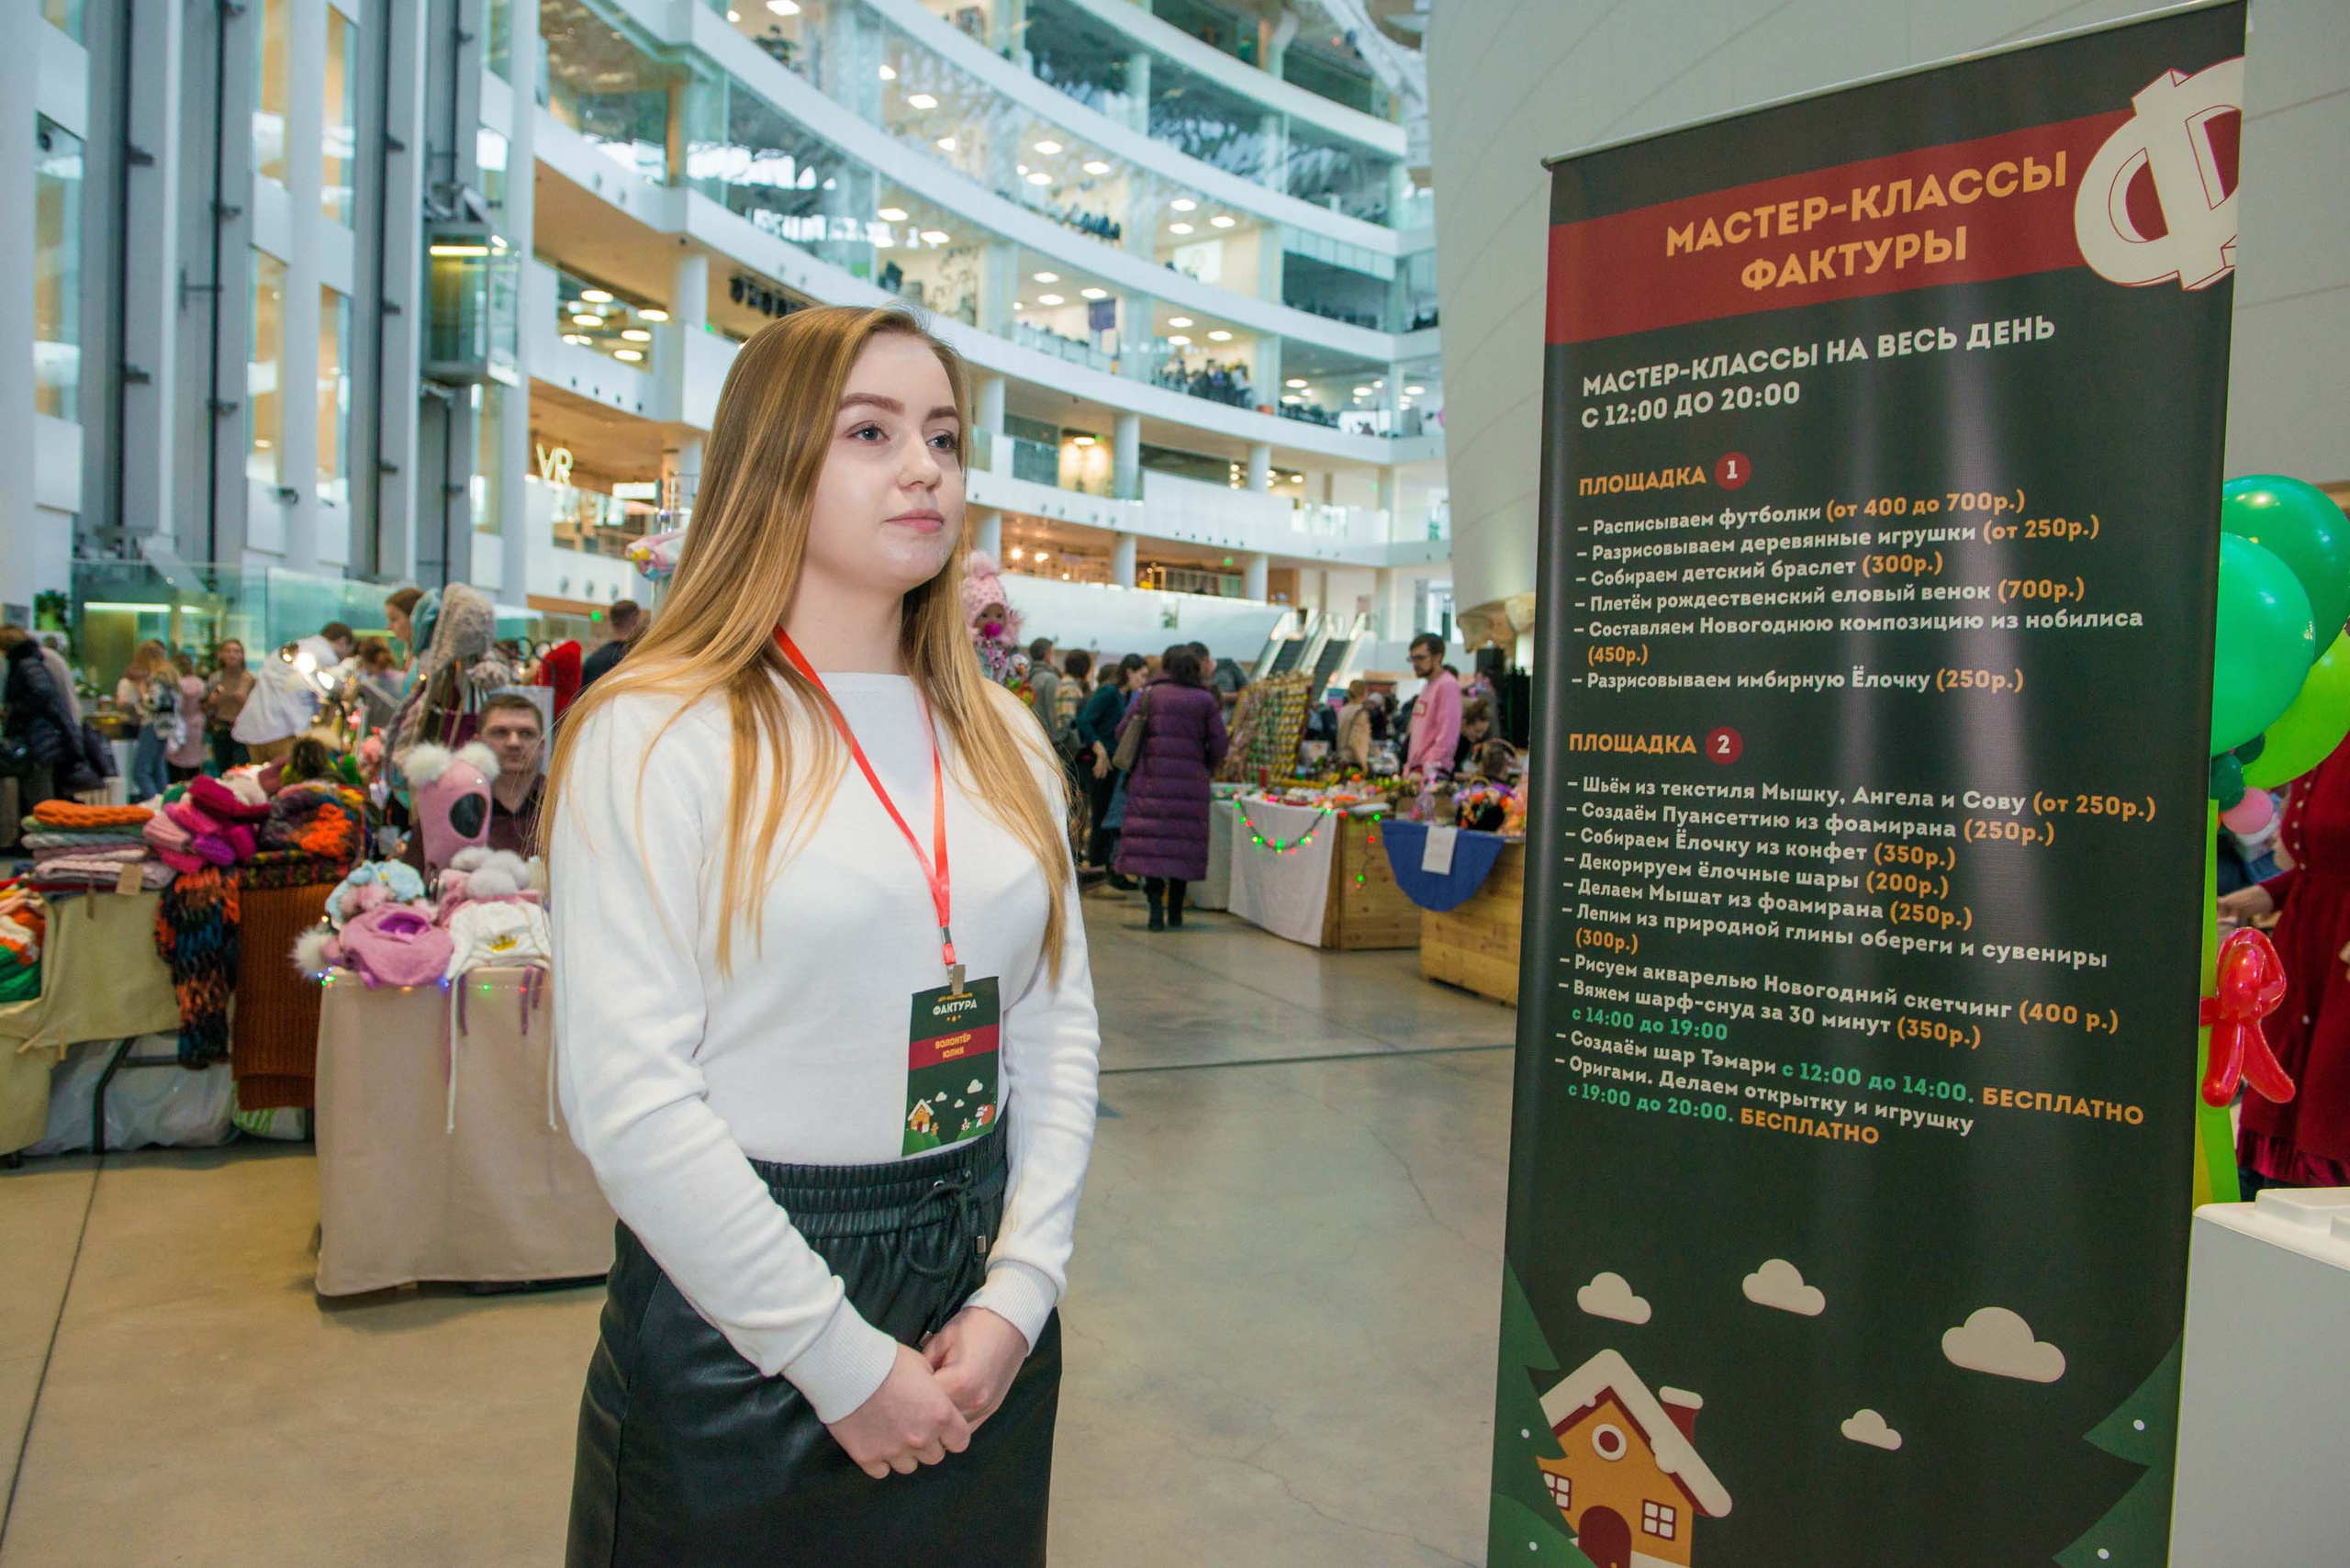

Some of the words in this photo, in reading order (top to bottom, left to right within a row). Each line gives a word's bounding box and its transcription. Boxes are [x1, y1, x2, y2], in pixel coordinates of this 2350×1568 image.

[1667, 151, 2066, 257] МАСТЕР-КЛАССЫ
[1740, 226, 1966, 292] ФАКТУРЫ
[1583, 342, 1818, 397] МАСТЕР-КЛАССЫ
[1828, 334, 1867, 364] НА
[1878, 327, 1957, 357] ВЕСЬ
[1966, 315, 2054, 351] ДЕНЬ
[1582, 402, 1598, 428] С
[1605, 396, 1667, 428] 12:00
[1674, 388, 1713, 419] ДО
[1721, 381, 1800, 411] 20:00
[536, 442, 573, 487] VR
[1579, 465, 1707, 496] ПЛОЩАДКА
[1727, 460, 1738, 479] 1
[1594, 512, 1713, 534] Расписываем
[1719, 506, 1820, 529] футболки
[1826, 499, 1858, 521] (от
[1863, 498, 1907, 516] 400
[1912, 500, 1940, 515] до
[1946, 488, 2025, 515] 700р.)
[1593, 539, 1734, 563] Разрисовываем
[1740, 532, 1871, 555] деревянные
[1878, 526, 1975, 548] игрушки
[1983, 520, 2018, 544] (от
[2025, 514, 2098, 541] 250р.)
[1591, 568, 1677, 588] Собираем
[1682, 561, 1764, 582] детский
[1772, 559, 1855, 582] браслет
[1863, 551, 1942, 577] (300р.)
[1591, 595, 1651, 611] Плетём
[1657, 586, 1825, 612] рождественский
[1831, 584, 1915, 603] еловый
[1921, 584, 1990, 600] венок
[1998, 577, 2084, 603] (700р.)
[1589, 621, 1694, 636] Составляем
[1700, 617, 1833, 634] Новогоднюю
[1840, 614, 1984, 631] композицию
[1992, 612, 2018, 629] из
[2026, 609, 2143, 628] нобилиса
[1588, 644, 1648, 666] (450р.)
[1588, 672, 1730, 692] Разрисовываем
[1737, 670, 1844, 692] имбирную
[1852, 666, 1930, 693] Ёлочку
[1937, 668, 2023, 692] (250р.)
[1569, 733, 1696, 755] ПЛОЩАДКА
[1718, 735, 1729, 754] 2
[1583, 776, 1629, 793] Шьём
[1636, 783, 1655, 795] из
[1662, 783, 1755, 799] текстиля
[1762, 783, 1845, 807] Мышку,
[1852, 786, 1934, 808] Ангела
[1942, 794, 1954, 808] и
[1963, 791, 2025, 815] Сову
[2033, 791, 2068, 816] (от
[2076, 795, 2155, 822] 250р.)
[1582, 801, 1656, 821] Создаём
[1663, 805, 1789, 828] Пуансеттию
[1796, 817, 1818, 830] из
[1825, 813, 1956, 839] фоамирана
[1964, 819, 2054, 846] (250р.)
[1581, 828, 1669, 849] Собираем
[1675, 829, 1750, 857] Ёлочку
[1757, 842, 1779, 855] из
[1786, 841, 1867, 864] конфет
[1874, 842, 1955, 871] (350р.)
[1579, 853, 1691, 879] Декорируем
[1698, 861, 1789, 883] ёлочные
[1796, 872, 1859, 891] шары
[1866, 870, 1949, 900] (200р.)
[1578, 878, 1642, 899] Делаем
[1650, 885, 1721, 905] Мышат
[1729, 895, 1751, 907] из
[1758, 892, 1883, 920] фоамирана
[1890, 901, 1972, 931] (250р.)
[1575, 927, 1638, 955] (300р.)
[1577, 903, 1631, 924] Лепим
[1637, 914, 1658, 927] из
[1664, 916, 1779, 938] природной
[1785, 925, 1852, 945] глины
[1861, 929, 1952, 955] обереги
[1961, 941, 1974, 956] и
[1982, 943, 2107, 969] сувениры
[933, 999, 977, 1015] ФАКТУРА
[1573, 980, 1629, 1002] Вяжем
[1636, 991, 1754, 1019] шарф-снуд
[1761, 1004, 1783, 1021] за
[1789, 1006, 1814, 1025] 30
[1822, 1013, 1891, 1036] минут
[1897, 1016, 1980, 1049] (350р.)
[1575, 954, 1637, 978] Рисуем
[1643, 965, 1758, 990] акварелью
[1764, 975, 1897, 1005] Новогодний
[1904, 993, 2011, 1018] скетчинг
[2020, 1000, 2077, 1025] (400
[2086, 1010, 2118, 1034] р.)
[1572, 1009, 1581, 1020] с
[1586, 1007, 1633, 1029] 14:00
[1639, 1019, 1663, 1034] до
[1670, 1019, 1728, 1041] 19:00
[1570, 1056, 1652, 1084] Оригами.
[1659, 1070, 1738, 1095] Делаем
[1744, 1086, 1847, 1116] открытку
[1854, 1103, 1867, 1115] и
[1875, 1104, 1974, 1137] игрушку
[1571, 1031, 1647, 1057] Создаём
[1653, 1047, 1695, 1067] шар
[1702, 1049, 1776, 1077] Тэмари
[1782, 1064, 1793, 1077] с
[1800, 1062, 1861, 1086] 12:00
[1868, 1073, 1896, 1091] до
[1903, 1075, 1974, 1103] 14:00.
[1983, 1087, 2143, 1125] БЕСПЛАТНО
[1568, 1084, 1577, 1096] с
[1582, 1084, 1630, 1106] 19:00
[1637, 1097, 1661, 1112] до
[1667, 1098, 1733, 1122] 20:00.
[1740, 1108, 1879, 1144] БЕСПЛАТНО
